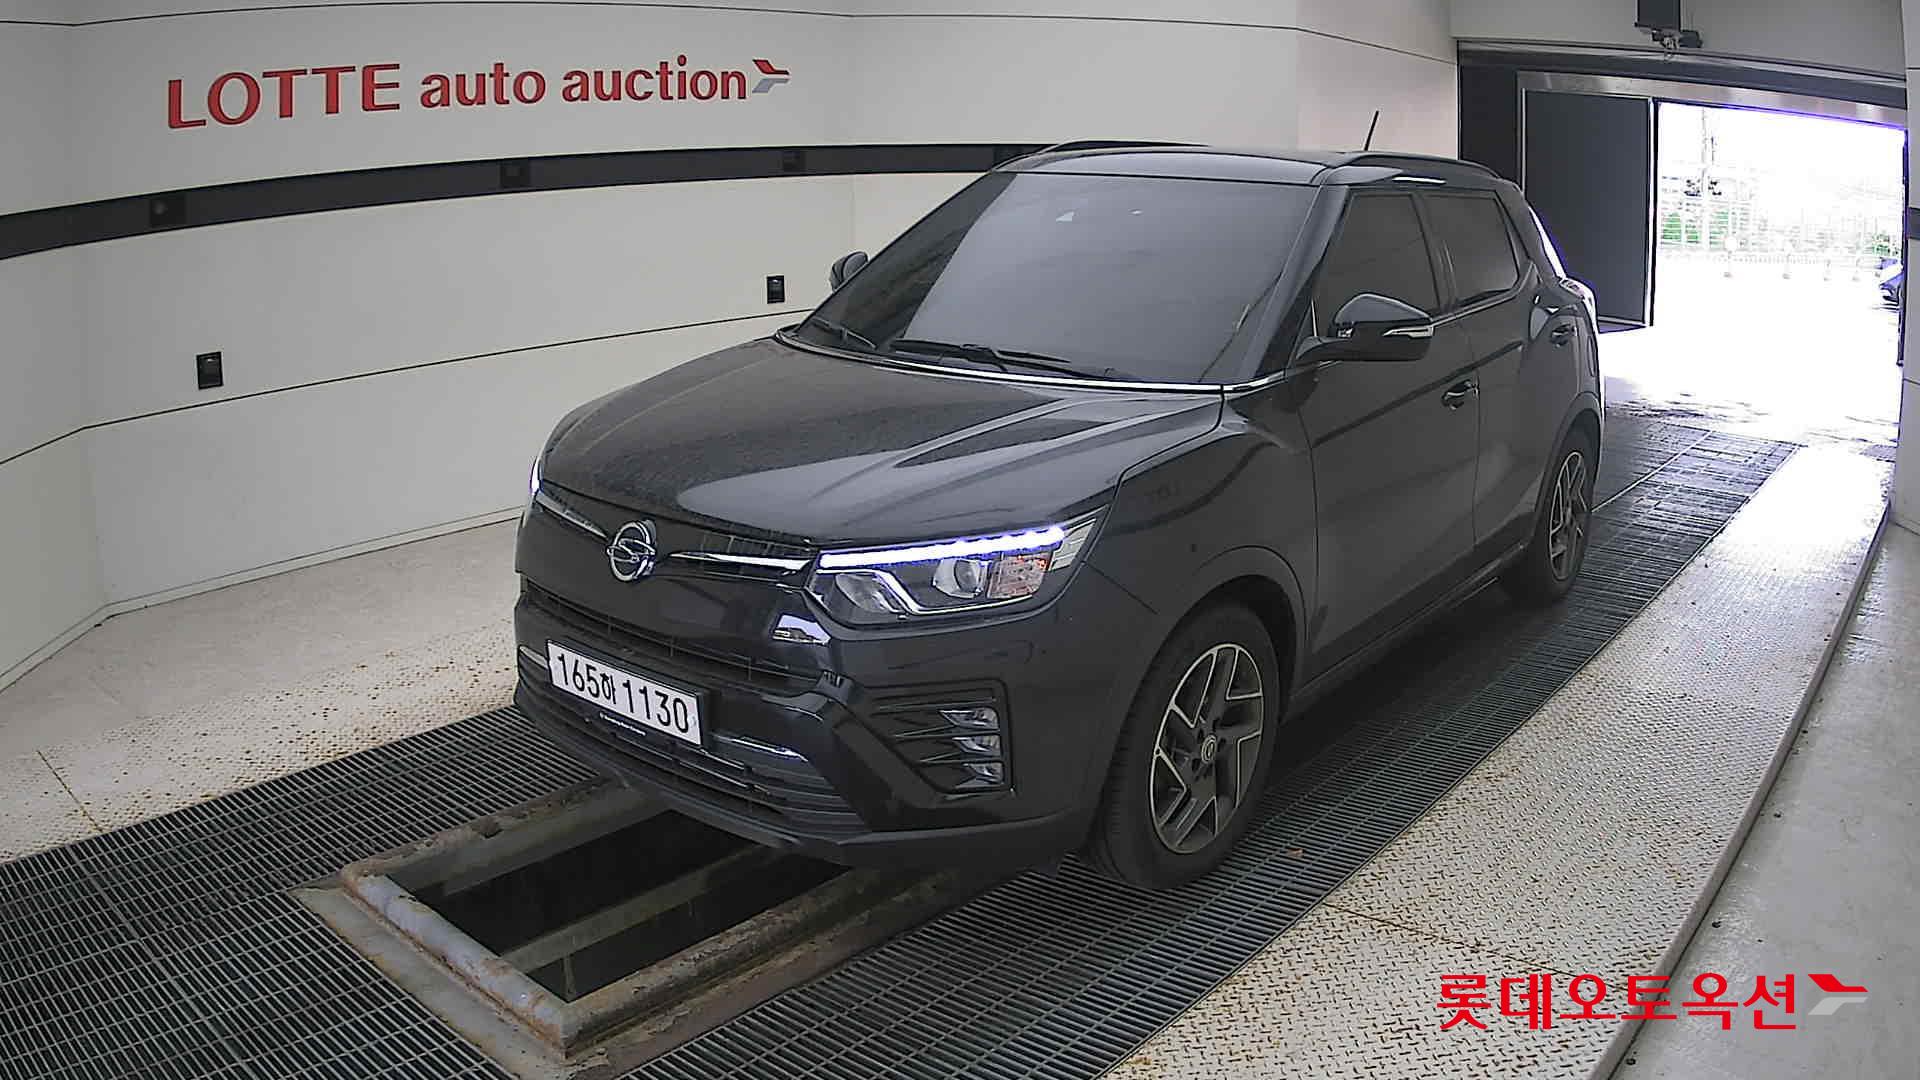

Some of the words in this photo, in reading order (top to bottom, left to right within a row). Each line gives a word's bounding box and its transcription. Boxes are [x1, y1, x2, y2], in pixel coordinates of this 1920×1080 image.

[168, 63, 400, 129] LOTTE
[419, 62, 546, 108] auto
[561, 54, 747, 101] auction
